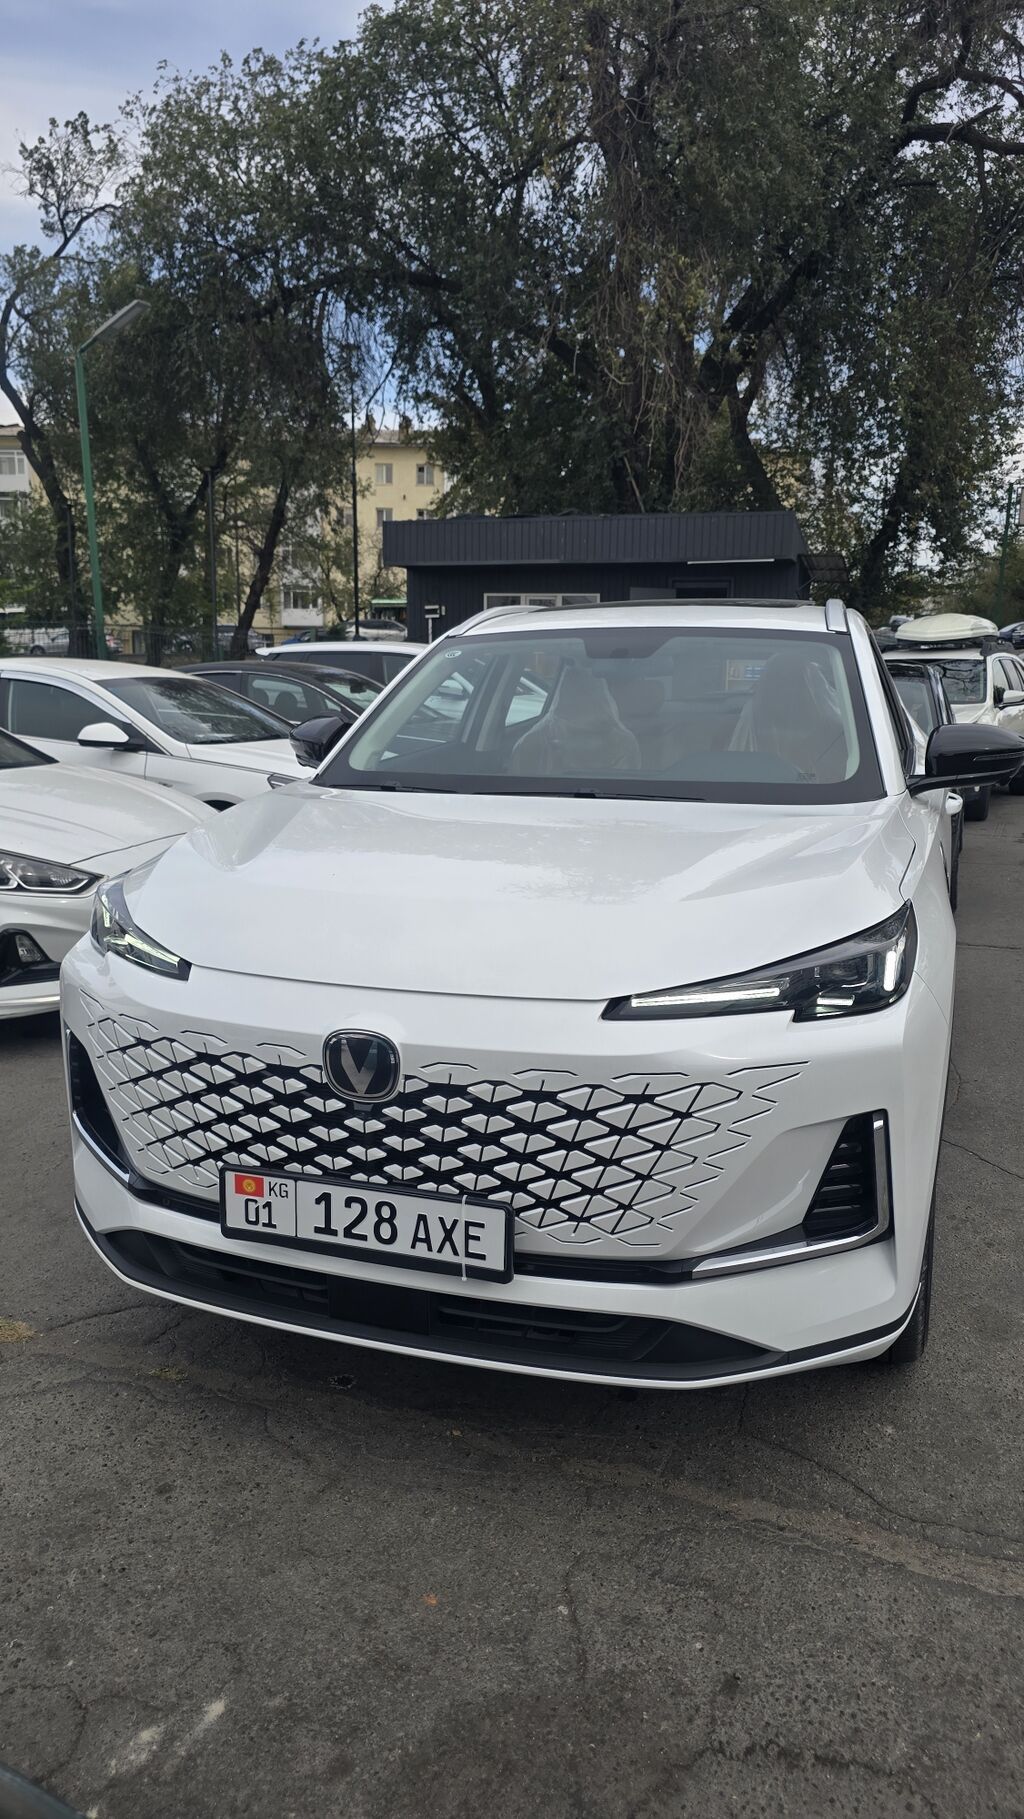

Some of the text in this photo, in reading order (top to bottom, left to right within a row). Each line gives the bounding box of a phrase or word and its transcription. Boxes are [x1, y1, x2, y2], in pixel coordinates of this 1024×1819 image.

[267, 1181, 289, 1199] KG
[244, 1198, 277, 1229] 01
[313, 1191, 487, 1261] 128 AXE
